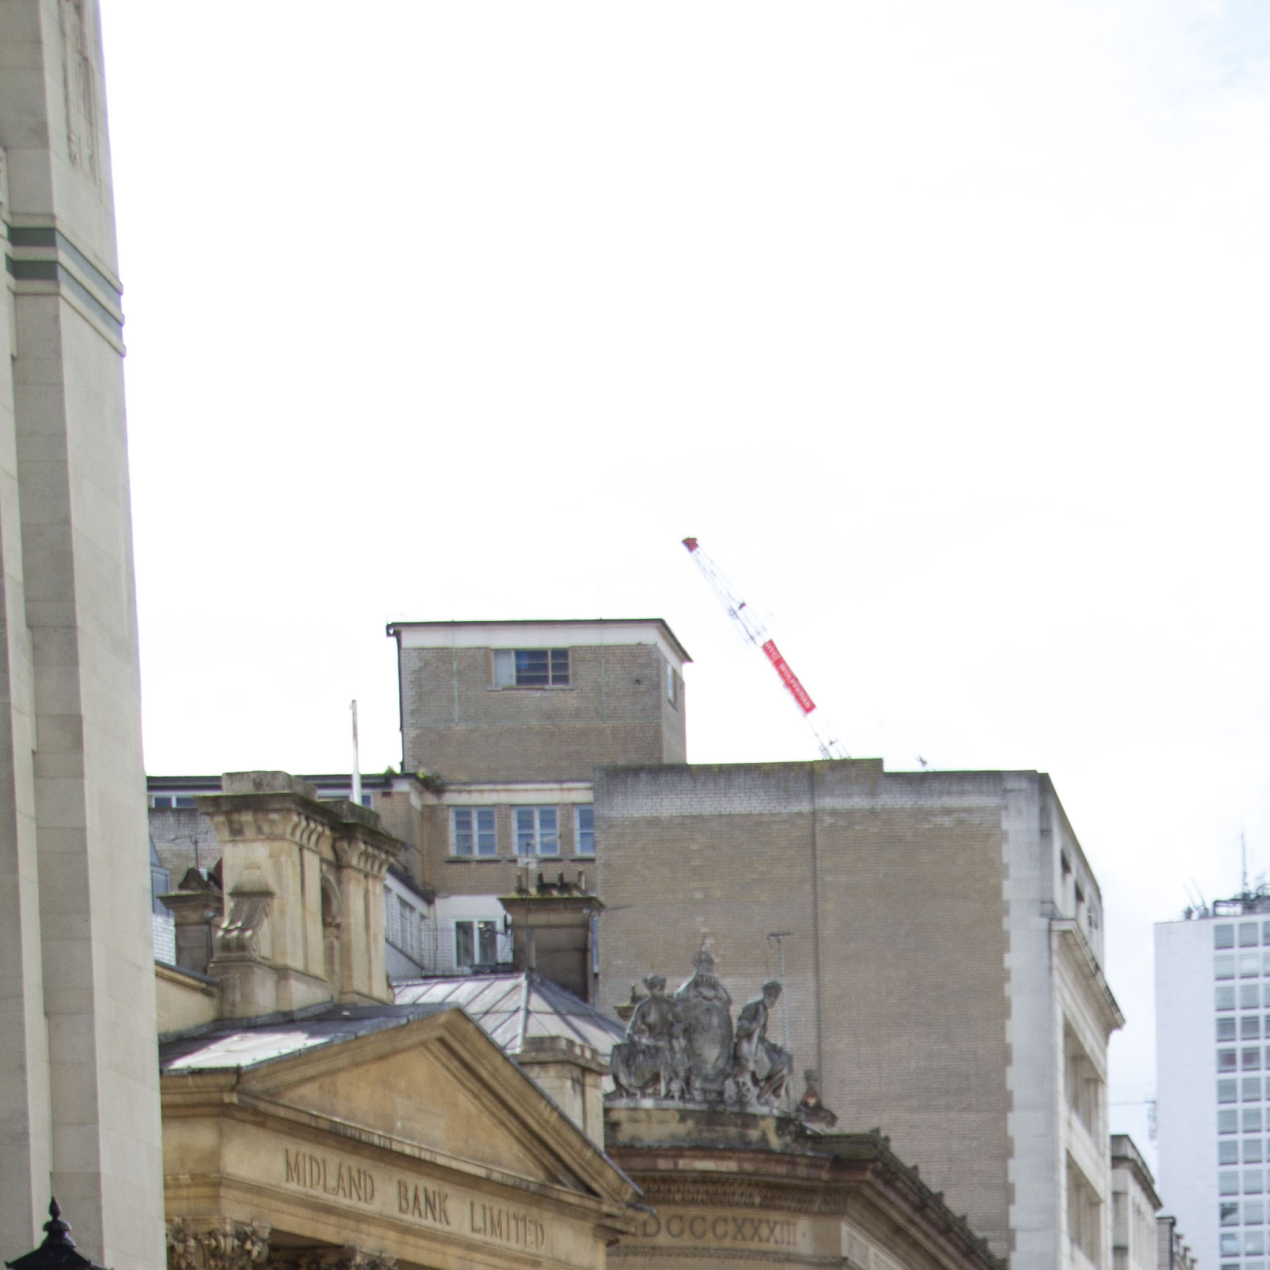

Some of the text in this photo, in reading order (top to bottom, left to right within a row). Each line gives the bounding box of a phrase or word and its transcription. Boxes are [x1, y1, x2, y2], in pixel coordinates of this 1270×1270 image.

[284, 1147, 546, 1250] MIDLAND BANK LIMITED
[634, 1214, 797, 1246] DCCCXXXIII
